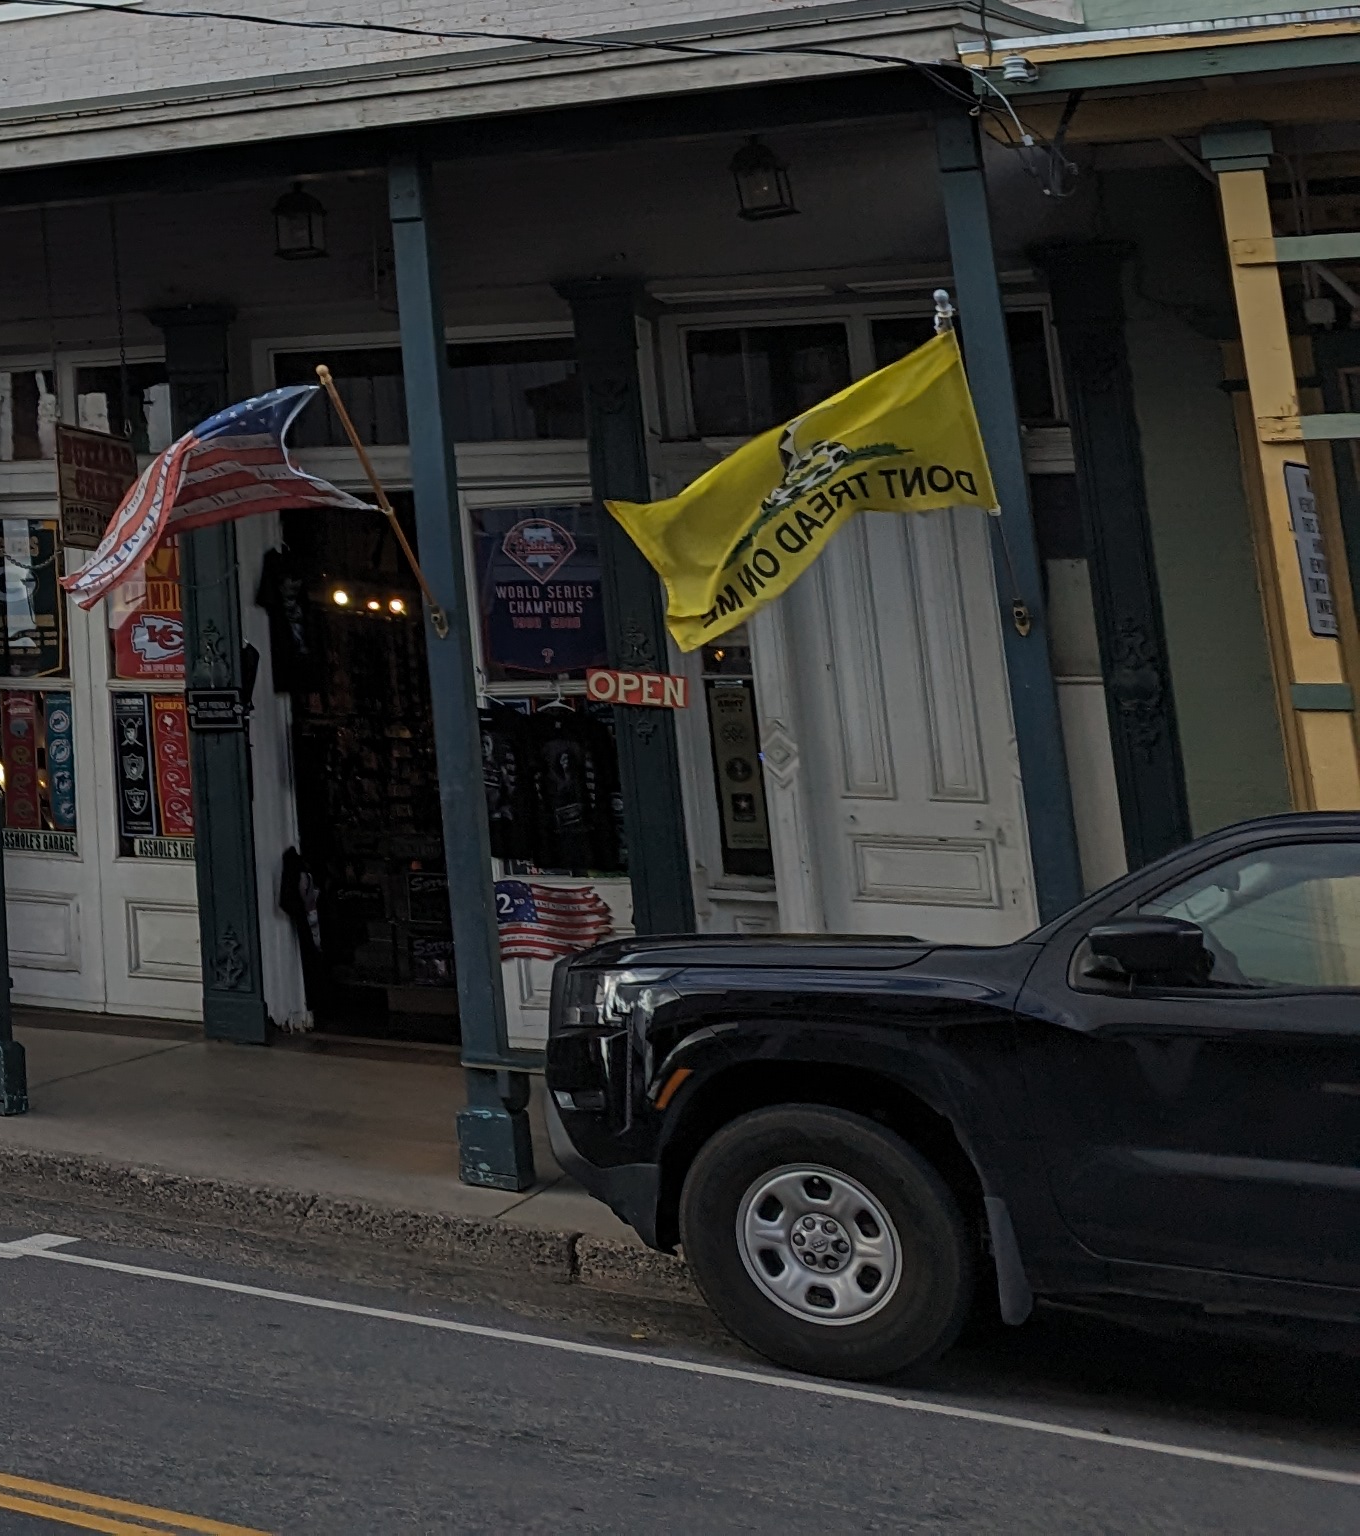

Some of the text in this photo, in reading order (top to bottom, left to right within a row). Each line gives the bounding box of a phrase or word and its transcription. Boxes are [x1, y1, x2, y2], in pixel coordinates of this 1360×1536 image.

[496, 585, 594, 598] WORLD SERIES
[509, 601, 583, 614] CHAMPIONS
[588, 671, 685, 707] OPEN
[43, 833, 75, 852] GARAGE
[138, 841, 178, 857] ASSHOLE'S
